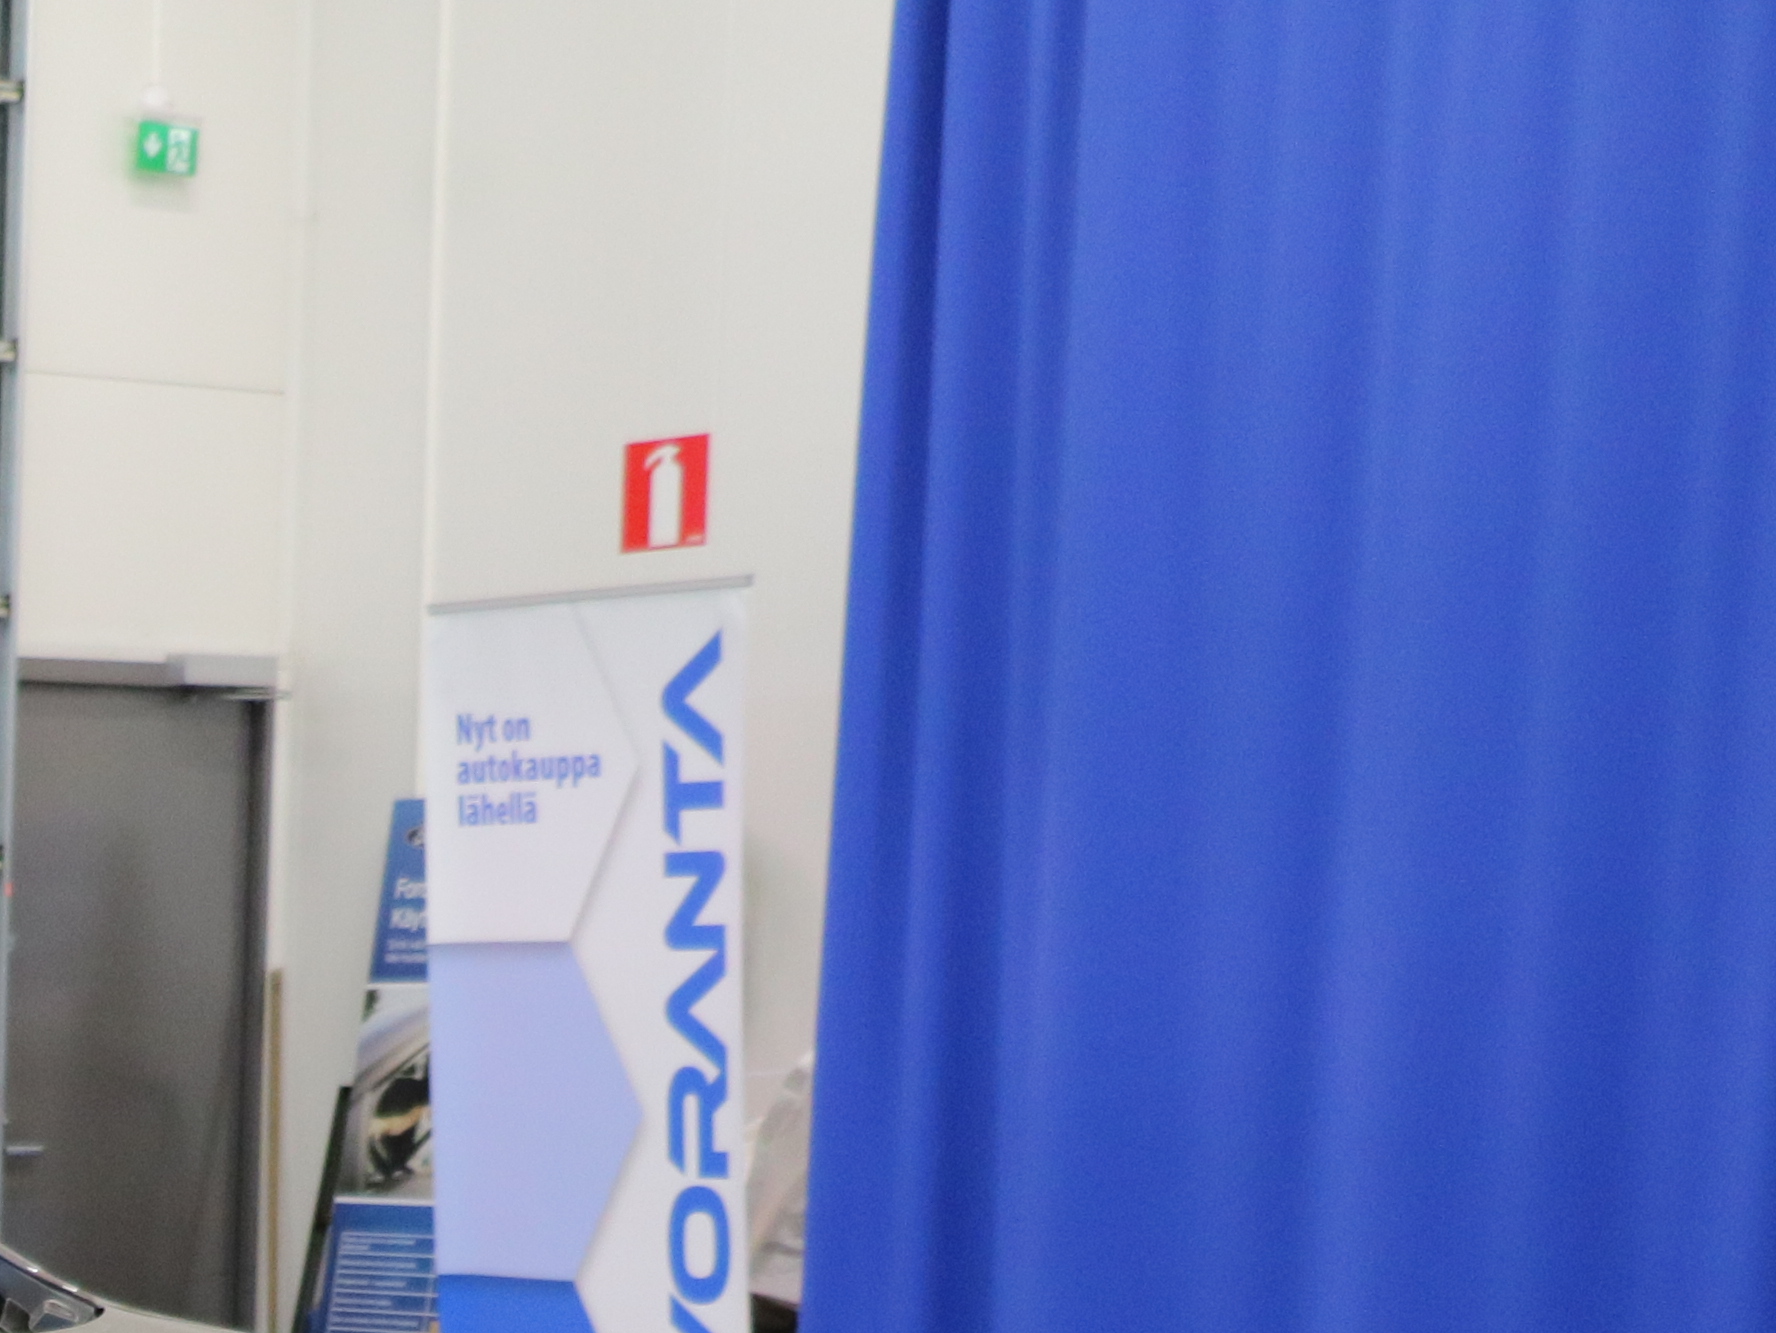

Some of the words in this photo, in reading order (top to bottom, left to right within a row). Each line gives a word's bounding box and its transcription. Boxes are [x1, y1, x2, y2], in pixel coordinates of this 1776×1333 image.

[457, 714, 497, 751] Nyt
[503, 717, 531, 742] on
[457, 751, 602, 788] autokauppa
[458, 792, 538, 827] lähellä
